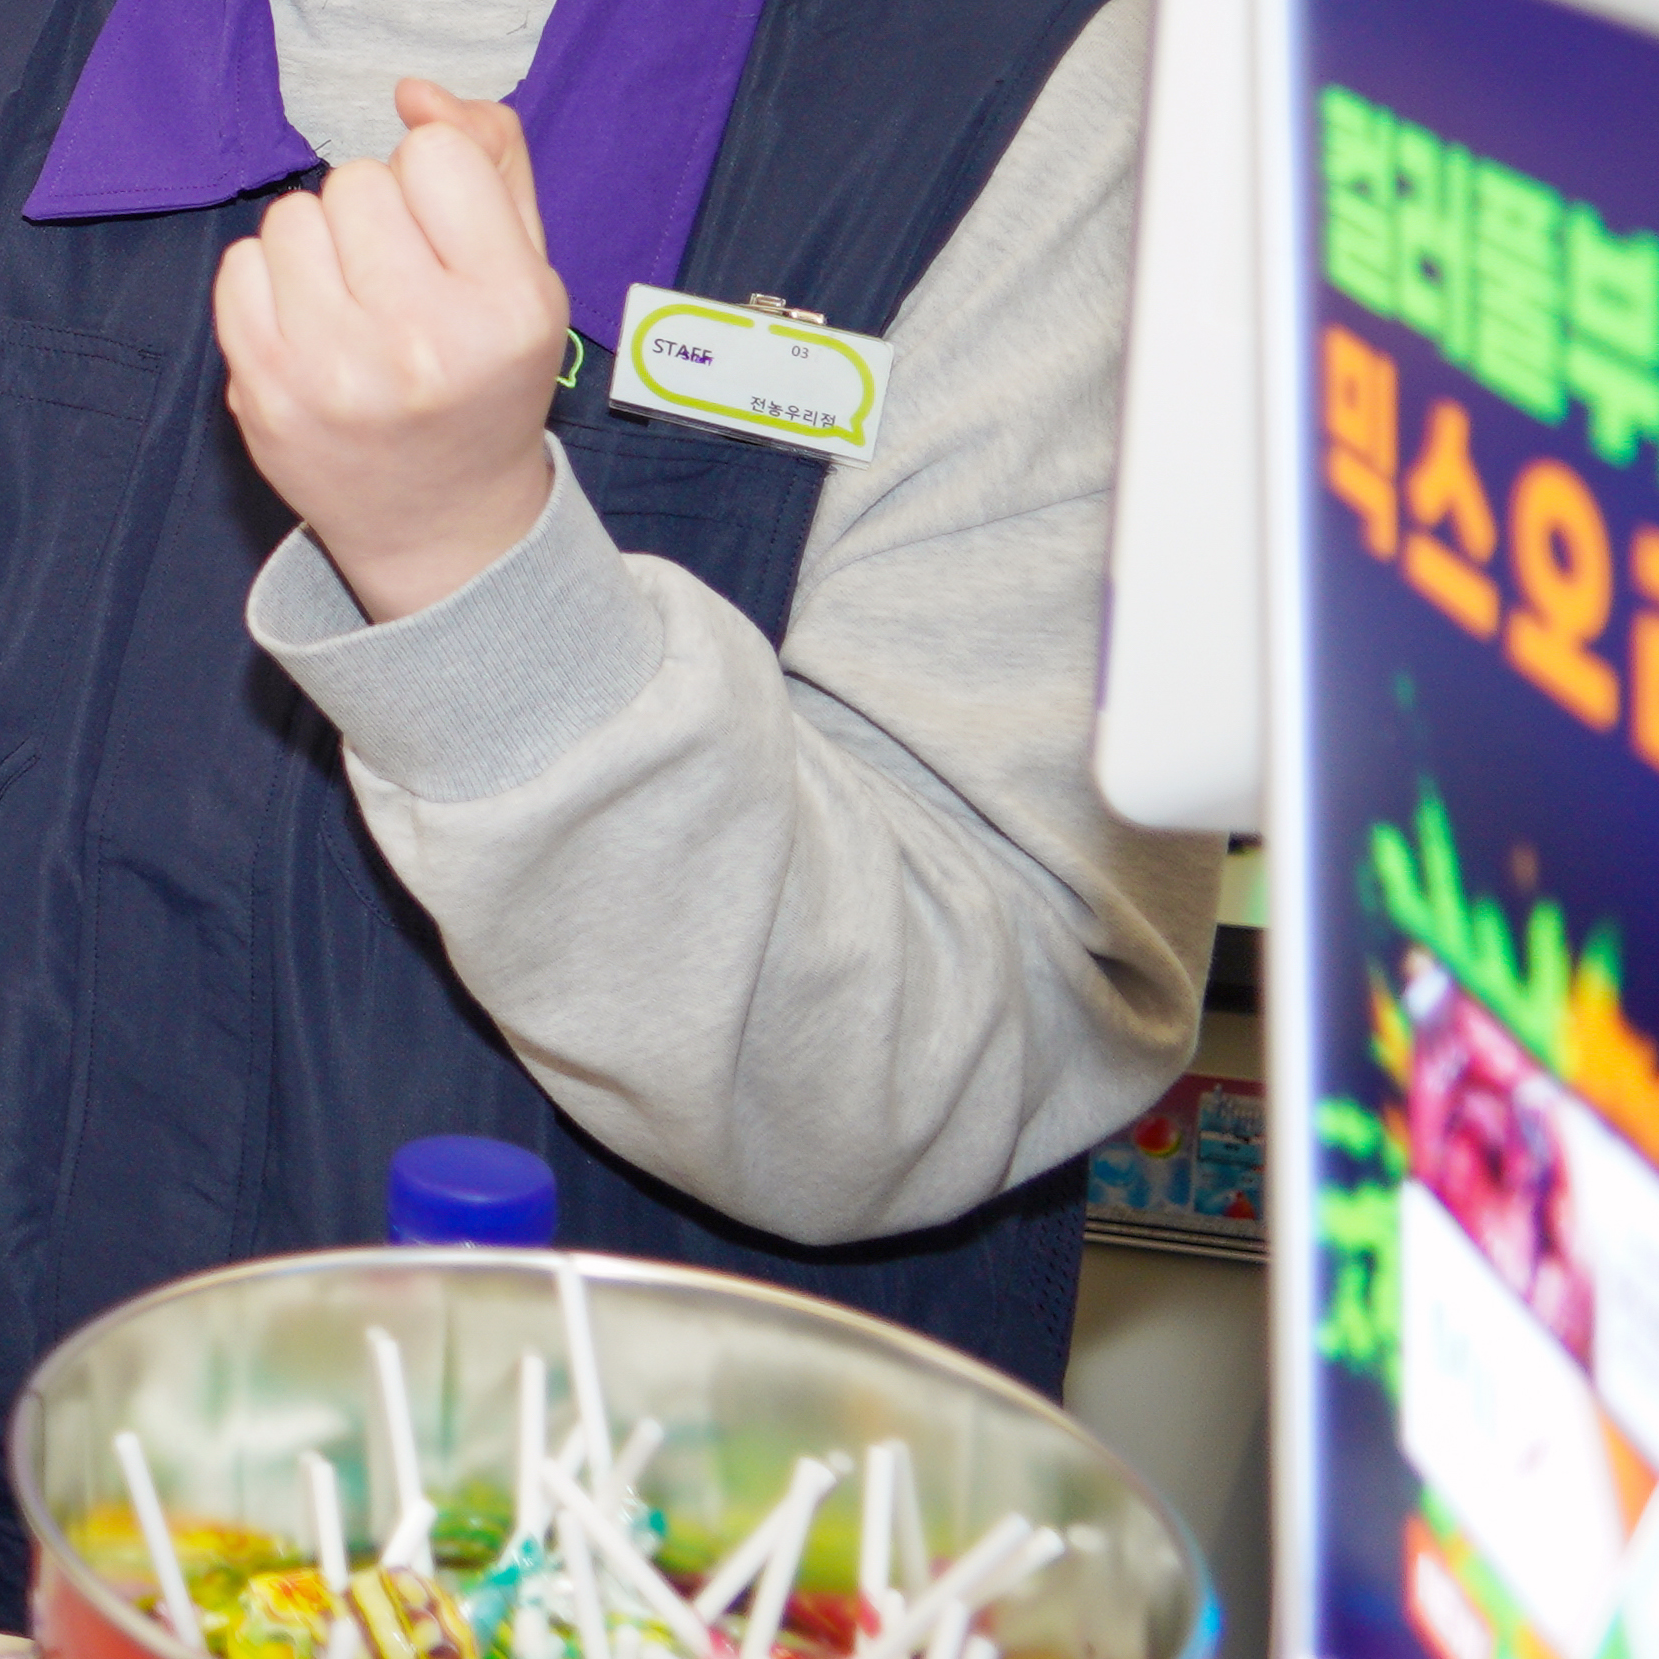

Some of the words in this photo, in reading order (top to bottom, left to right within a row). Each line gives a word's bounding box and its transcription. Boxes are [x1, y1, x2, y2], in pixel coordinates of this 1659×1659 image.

[652, 337, 714, 364] STAFF
[790, 344, 810, 360] 03
[749, 396, 837, 429] 전농우리점
